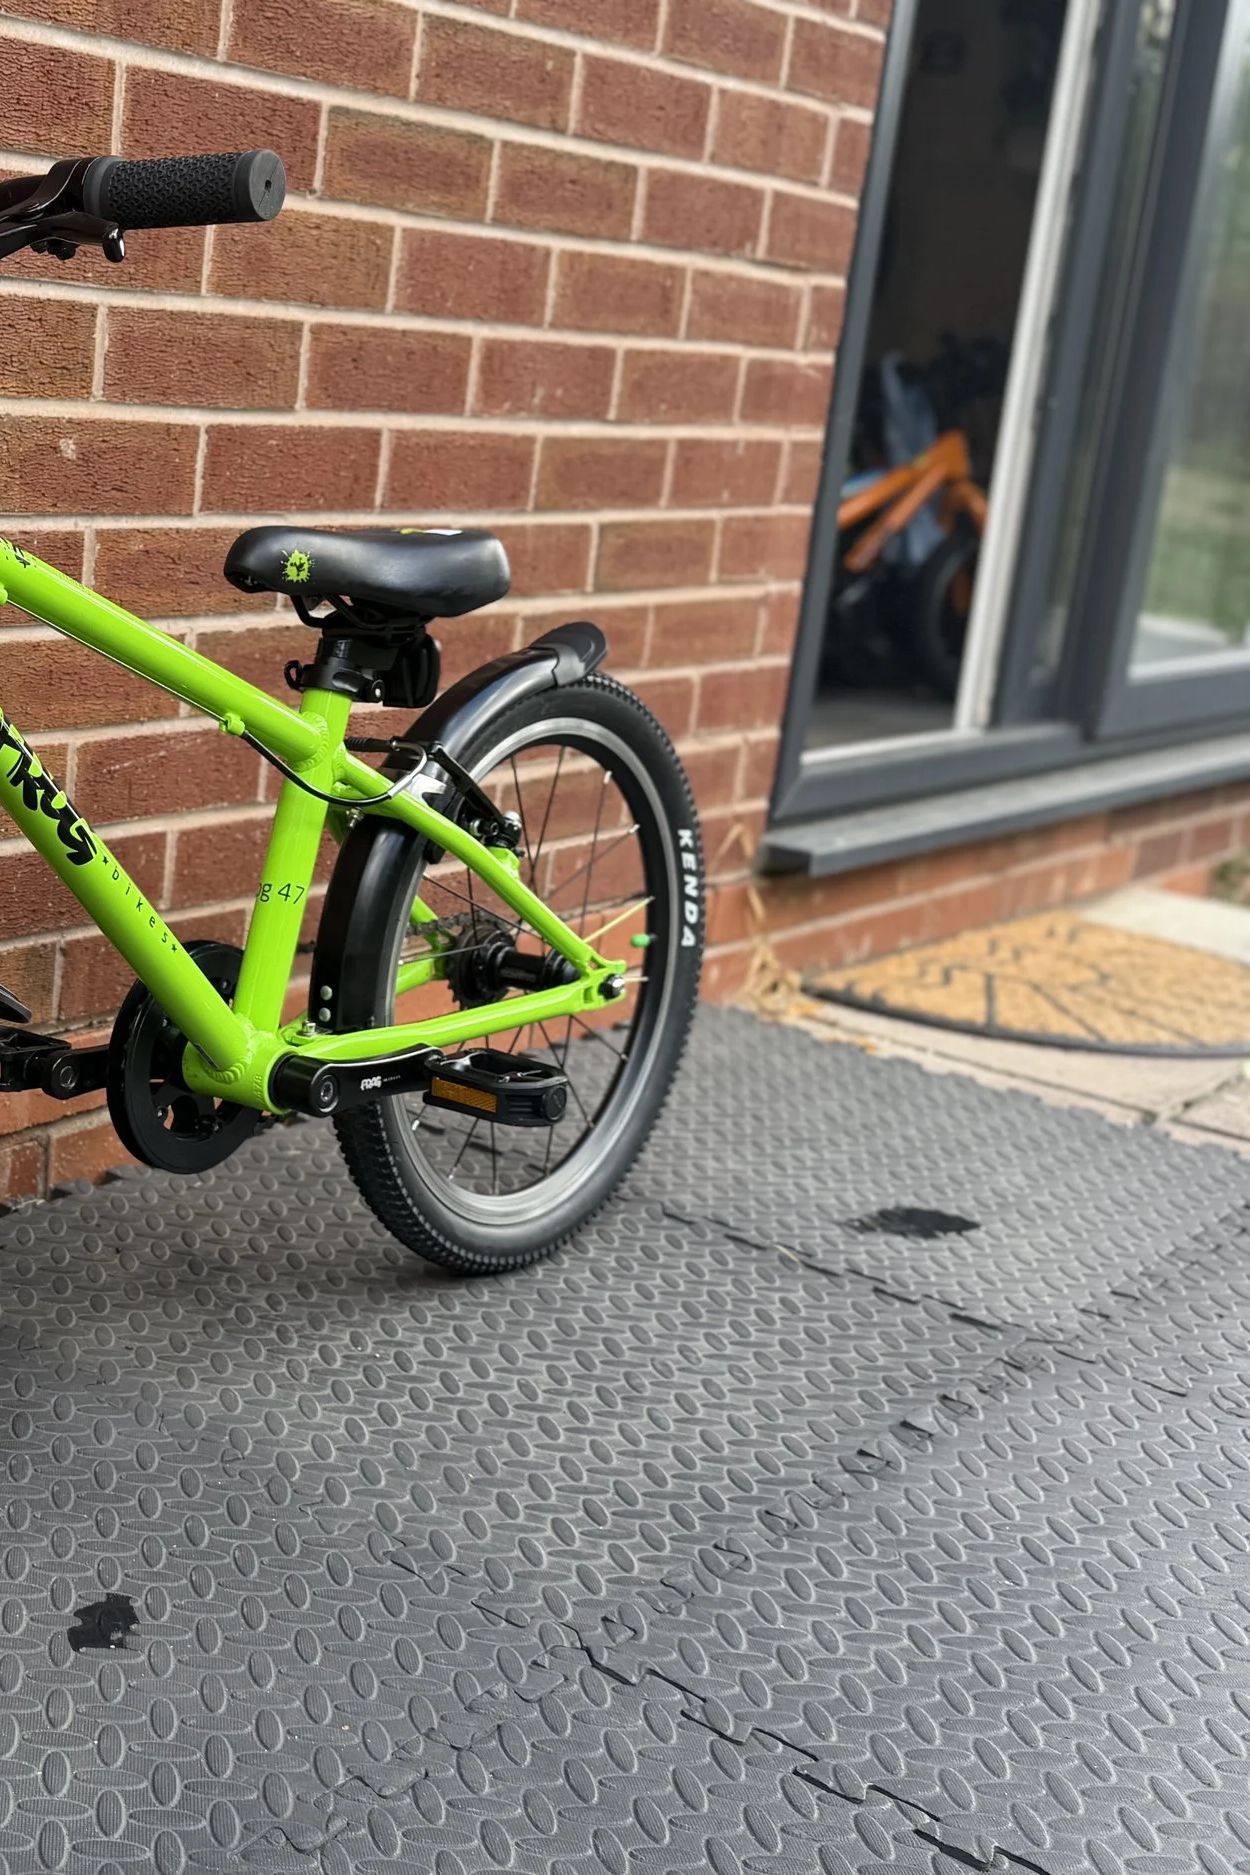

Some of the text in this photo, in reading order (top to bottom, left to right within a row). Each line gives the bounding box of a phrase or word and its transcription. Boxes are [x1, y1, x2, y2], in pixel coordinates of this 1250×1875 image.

[111, 865, 169, 944] bikes
[278, 883, 305, 904] 47
[677, 829, 699, 947] KENDA
